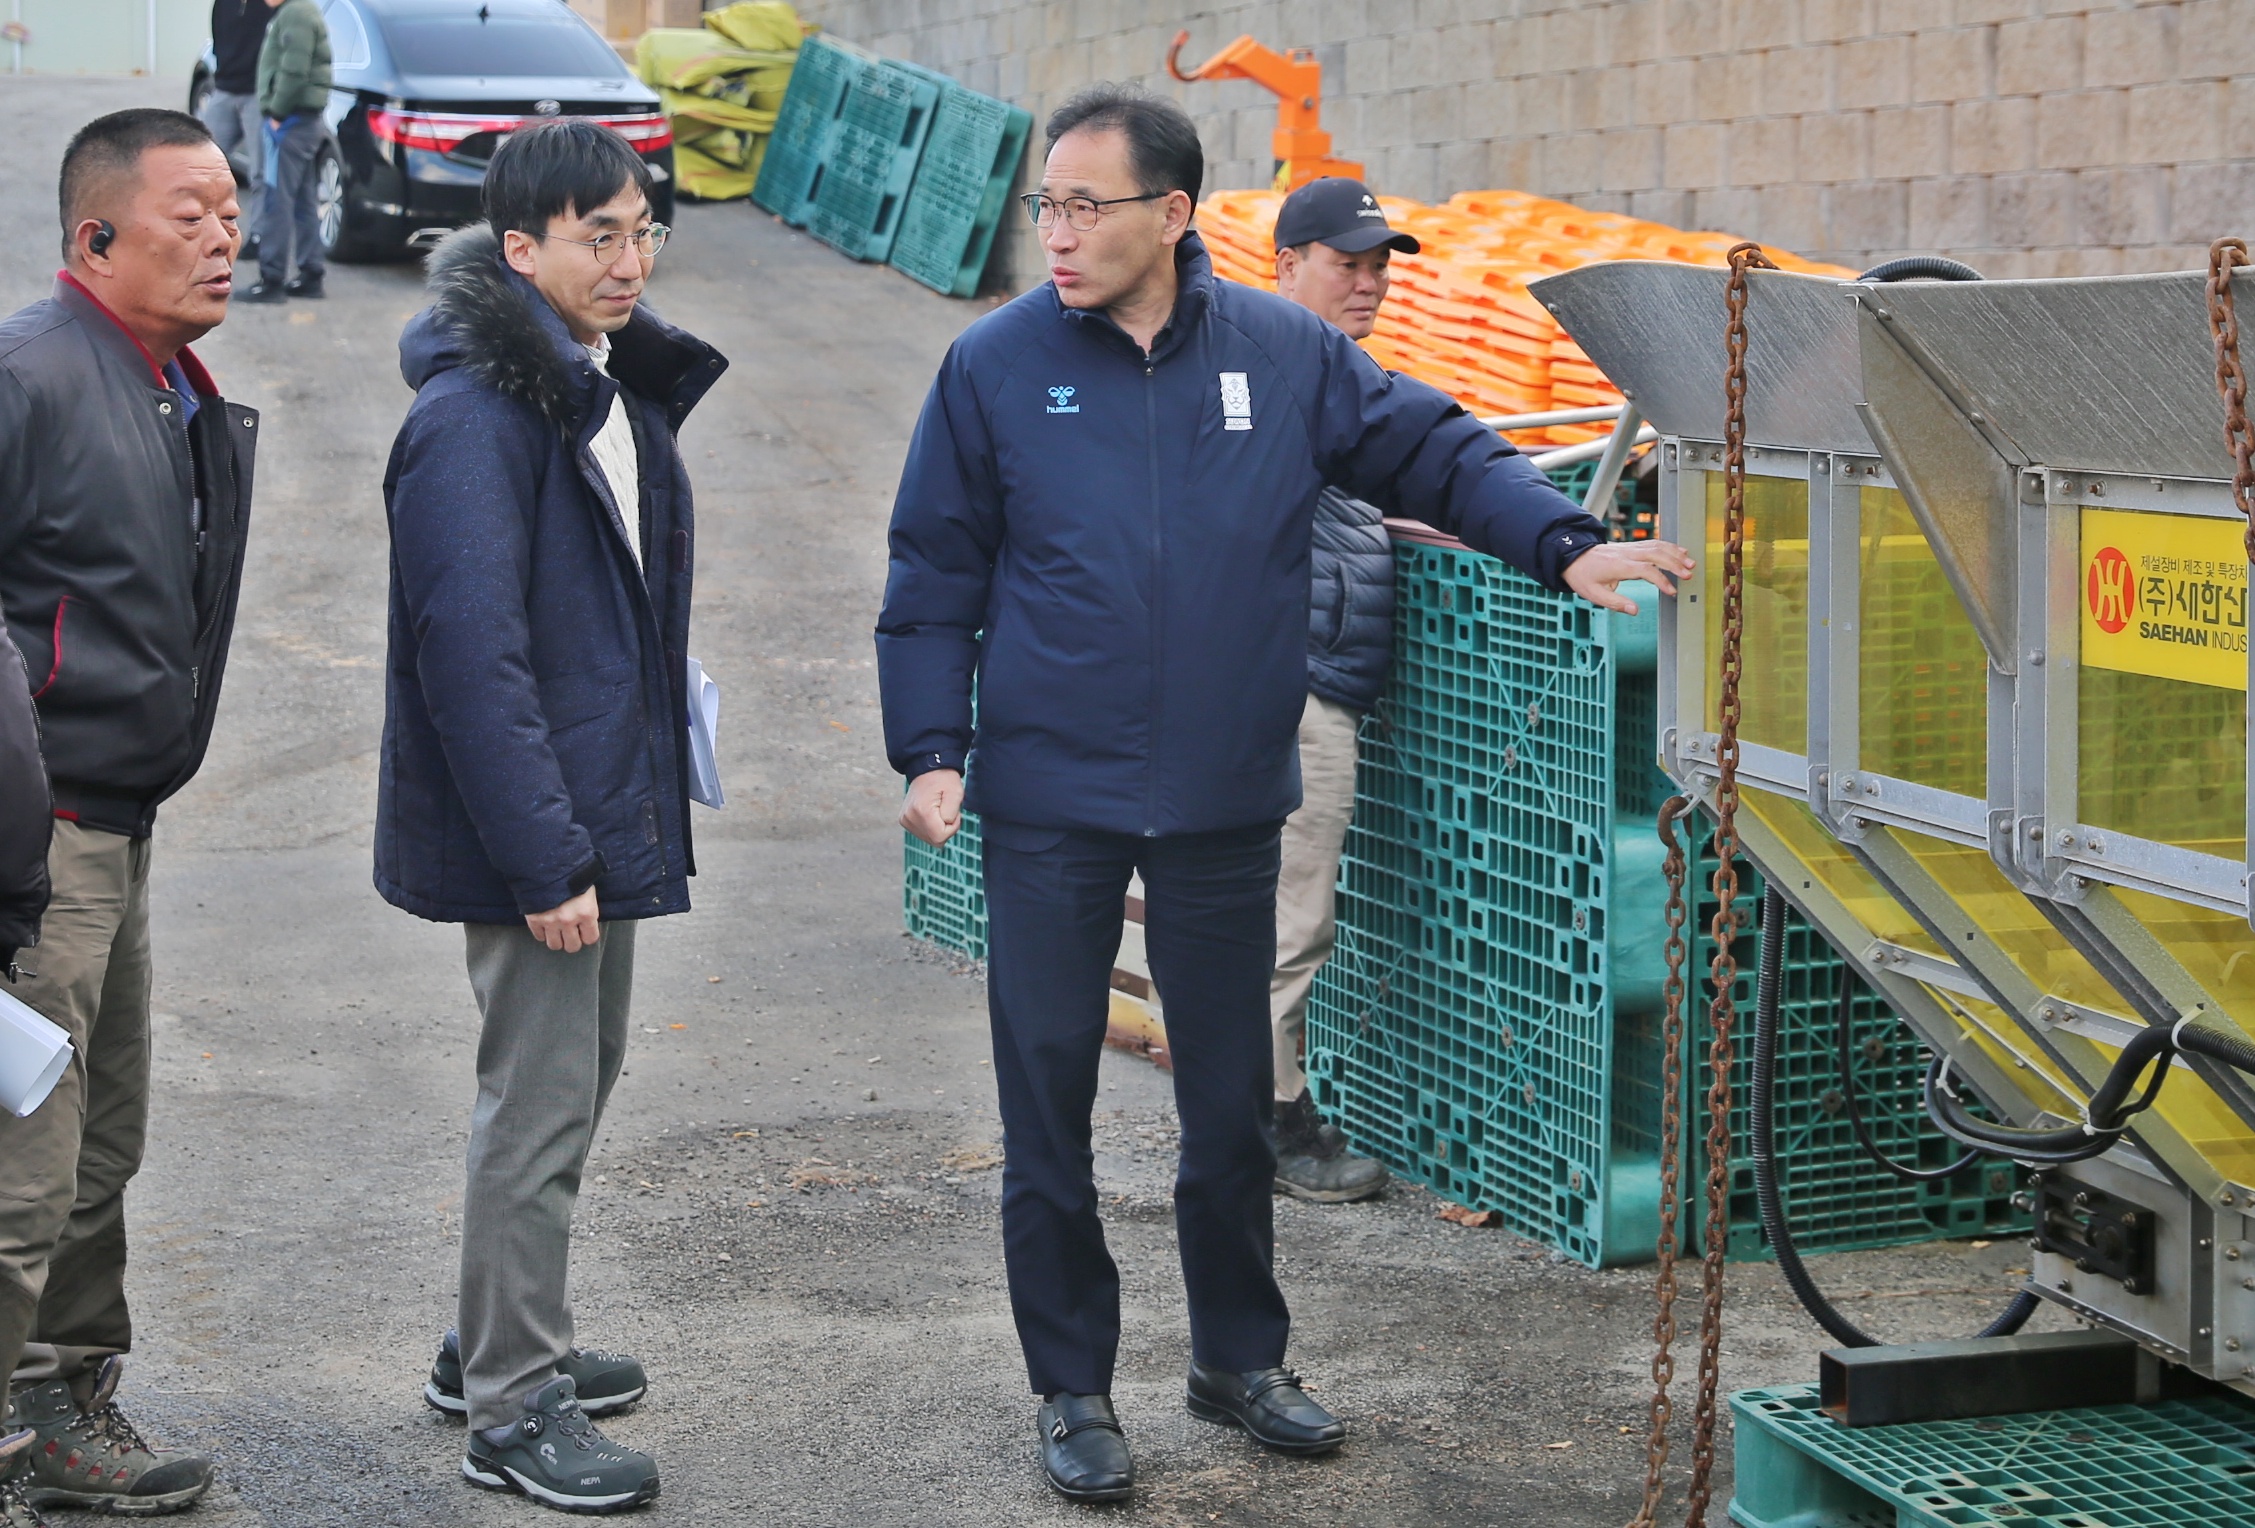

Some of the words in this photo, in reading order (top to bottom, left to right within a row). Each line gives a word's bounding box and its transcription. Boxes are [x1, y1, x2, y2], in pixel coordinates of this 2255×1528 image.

[1046, 404, 1080, 414] hummel
[2140, 555, 2180, 574] 제설장비
[2182, 559, 2203, 576] 제조
[2205, 561, 2215, 578] 및
[2139, 621, 2208, 647] SAEHAN
[2212, 630, 2247, 653] INDUS
[558, 1399, 576, 1411] NEPA
[580, 1476, 601, 1486] NEPA
